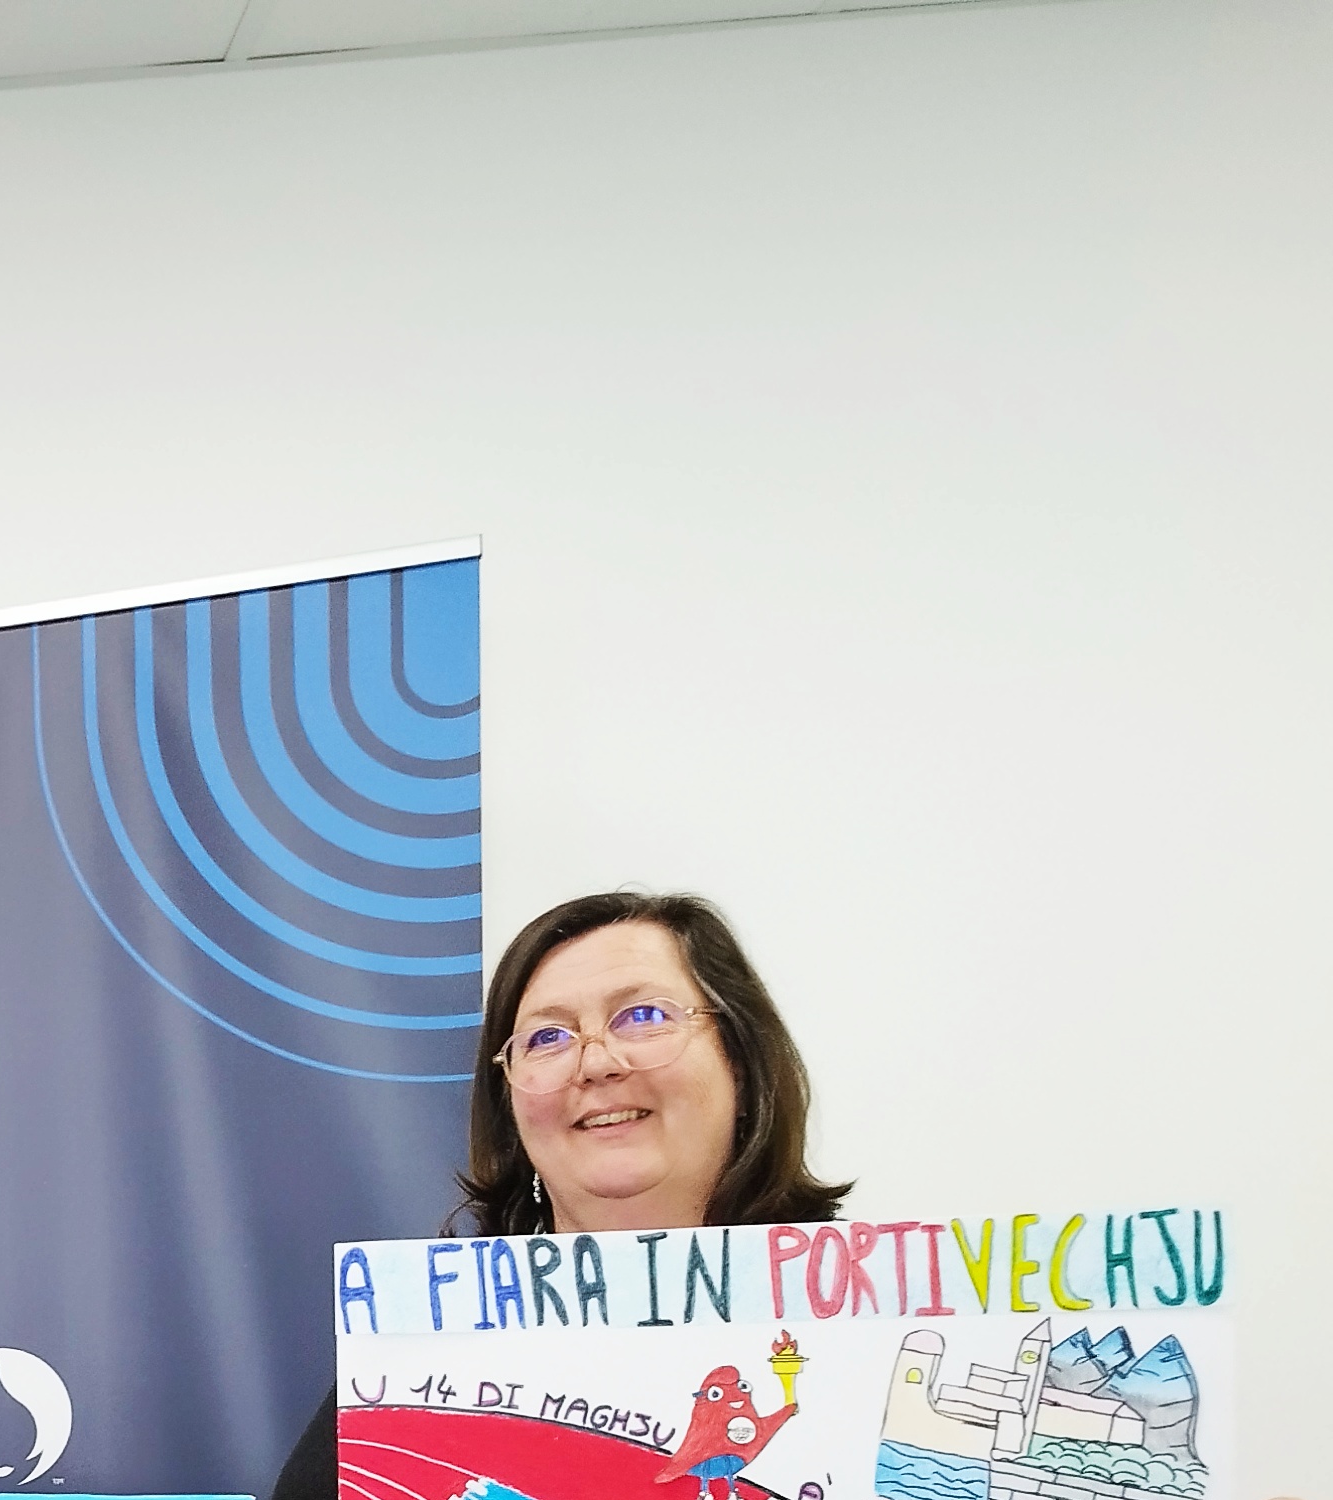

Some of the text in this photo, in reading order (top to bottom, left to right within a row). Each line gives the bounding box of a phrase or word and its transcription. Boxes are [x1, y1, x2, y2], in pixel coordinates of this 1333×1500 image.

[339, 1207, 1226, 1335] A FIARA IN PORTIVECHJU
[351, 1373, 678, 1447] U 14 DI MAGHJU
